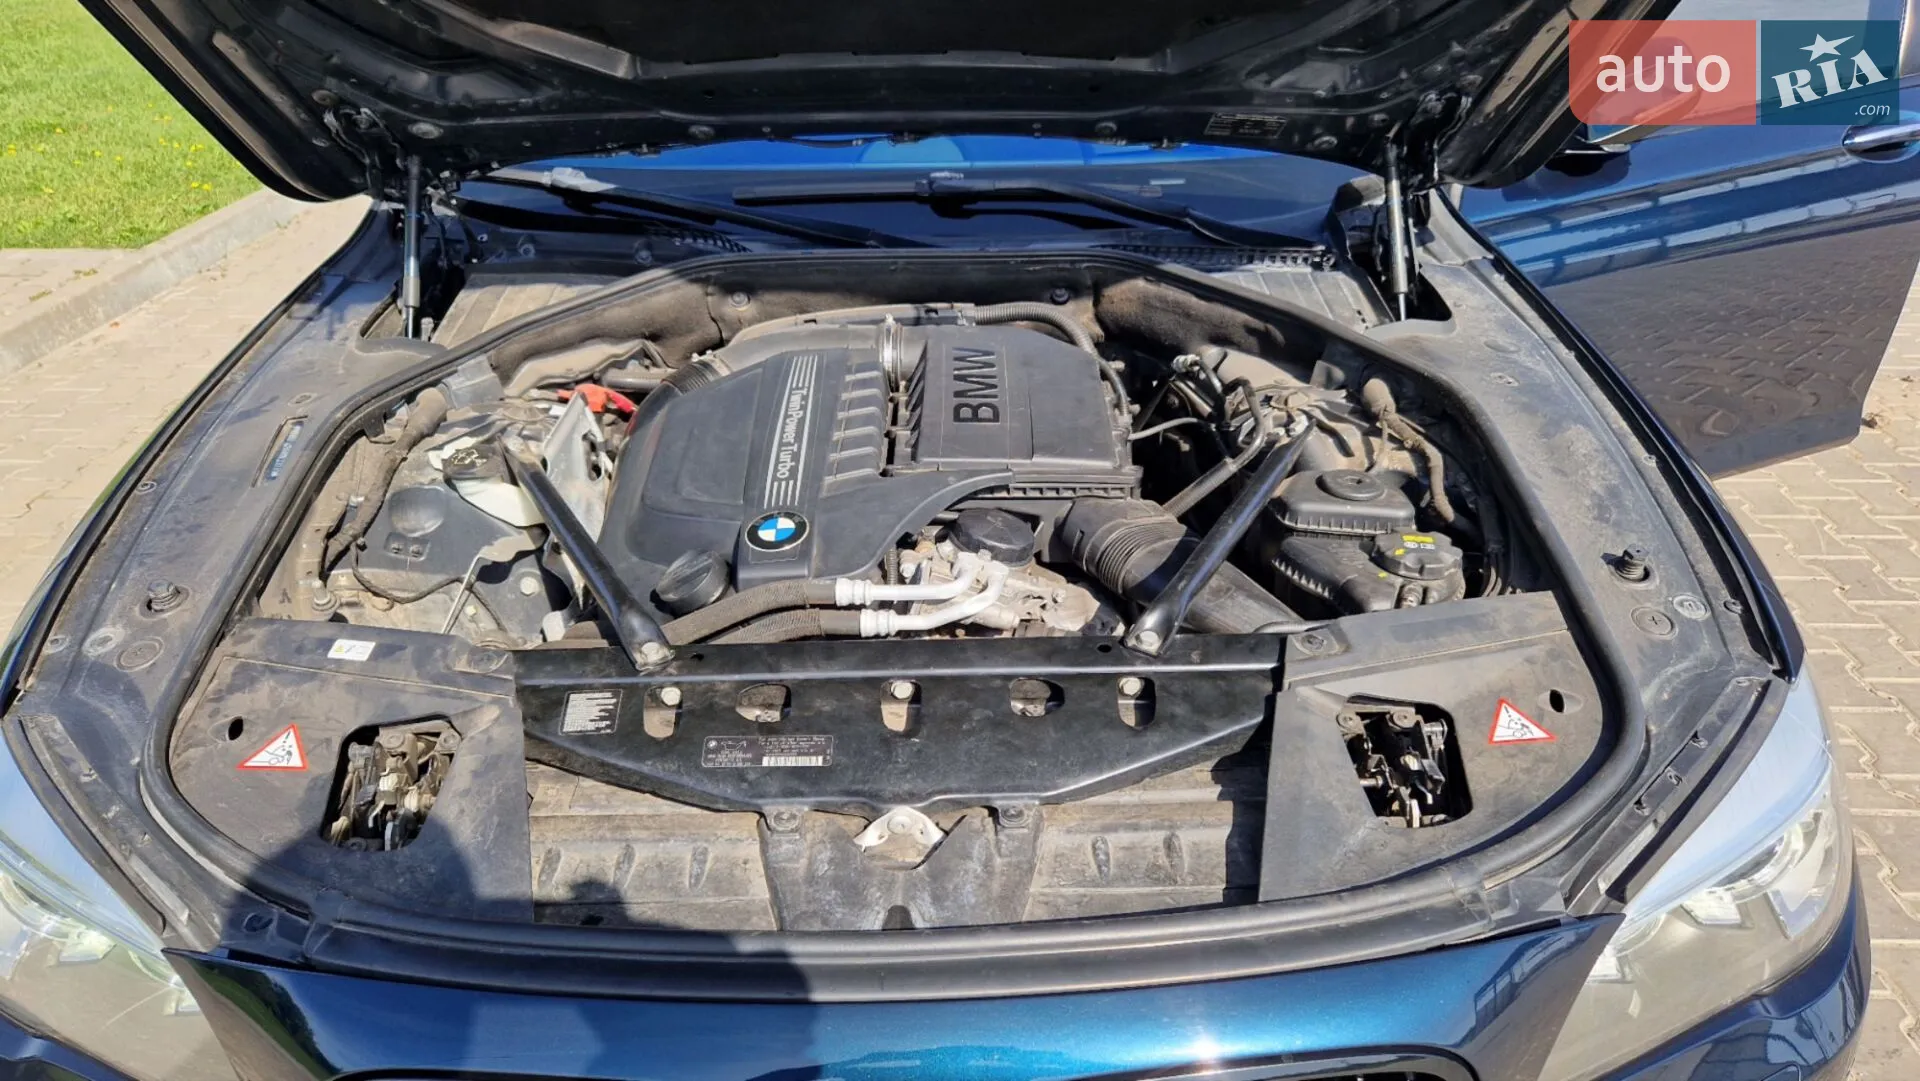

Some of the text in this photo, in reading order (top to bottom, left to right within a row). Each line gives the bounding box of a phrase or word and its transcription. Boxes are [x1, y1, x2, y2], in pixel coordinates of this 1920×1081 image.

[952, 347, 1000, 423] BMW
[777, 387, 808, 479] TwinPower Turbo
